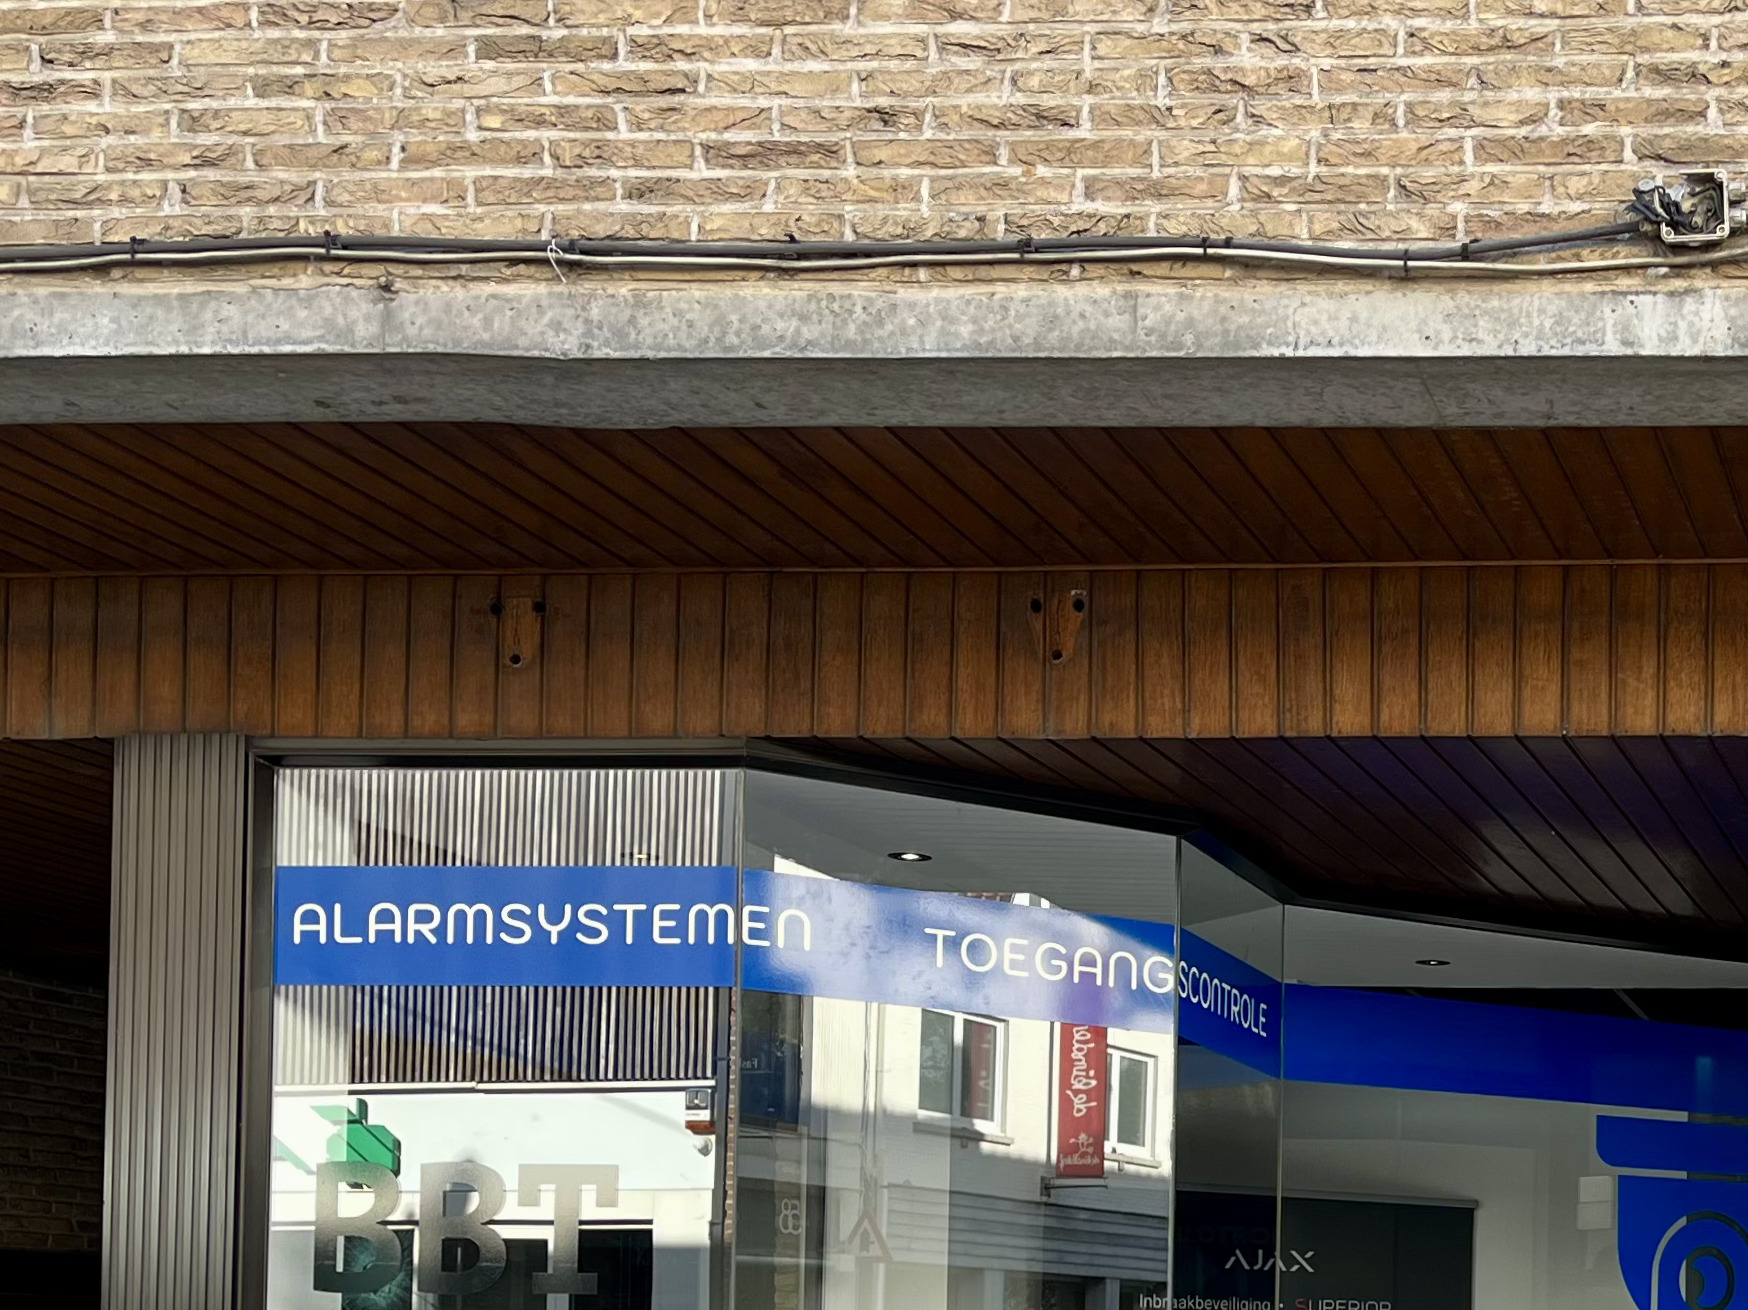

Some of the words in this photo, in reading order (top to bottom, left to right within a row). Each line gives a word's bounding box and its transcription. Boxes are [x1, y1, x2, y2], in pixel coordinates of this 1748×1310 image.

[292, 901, 814, 952] ALARMSYSTEMEN
[922, 926, 1270, 1039] TOEGANGSCONTROLE
[313, 1161, 619, 1295] BBT
[1224, 1249, 1316, 1273] AJAX
